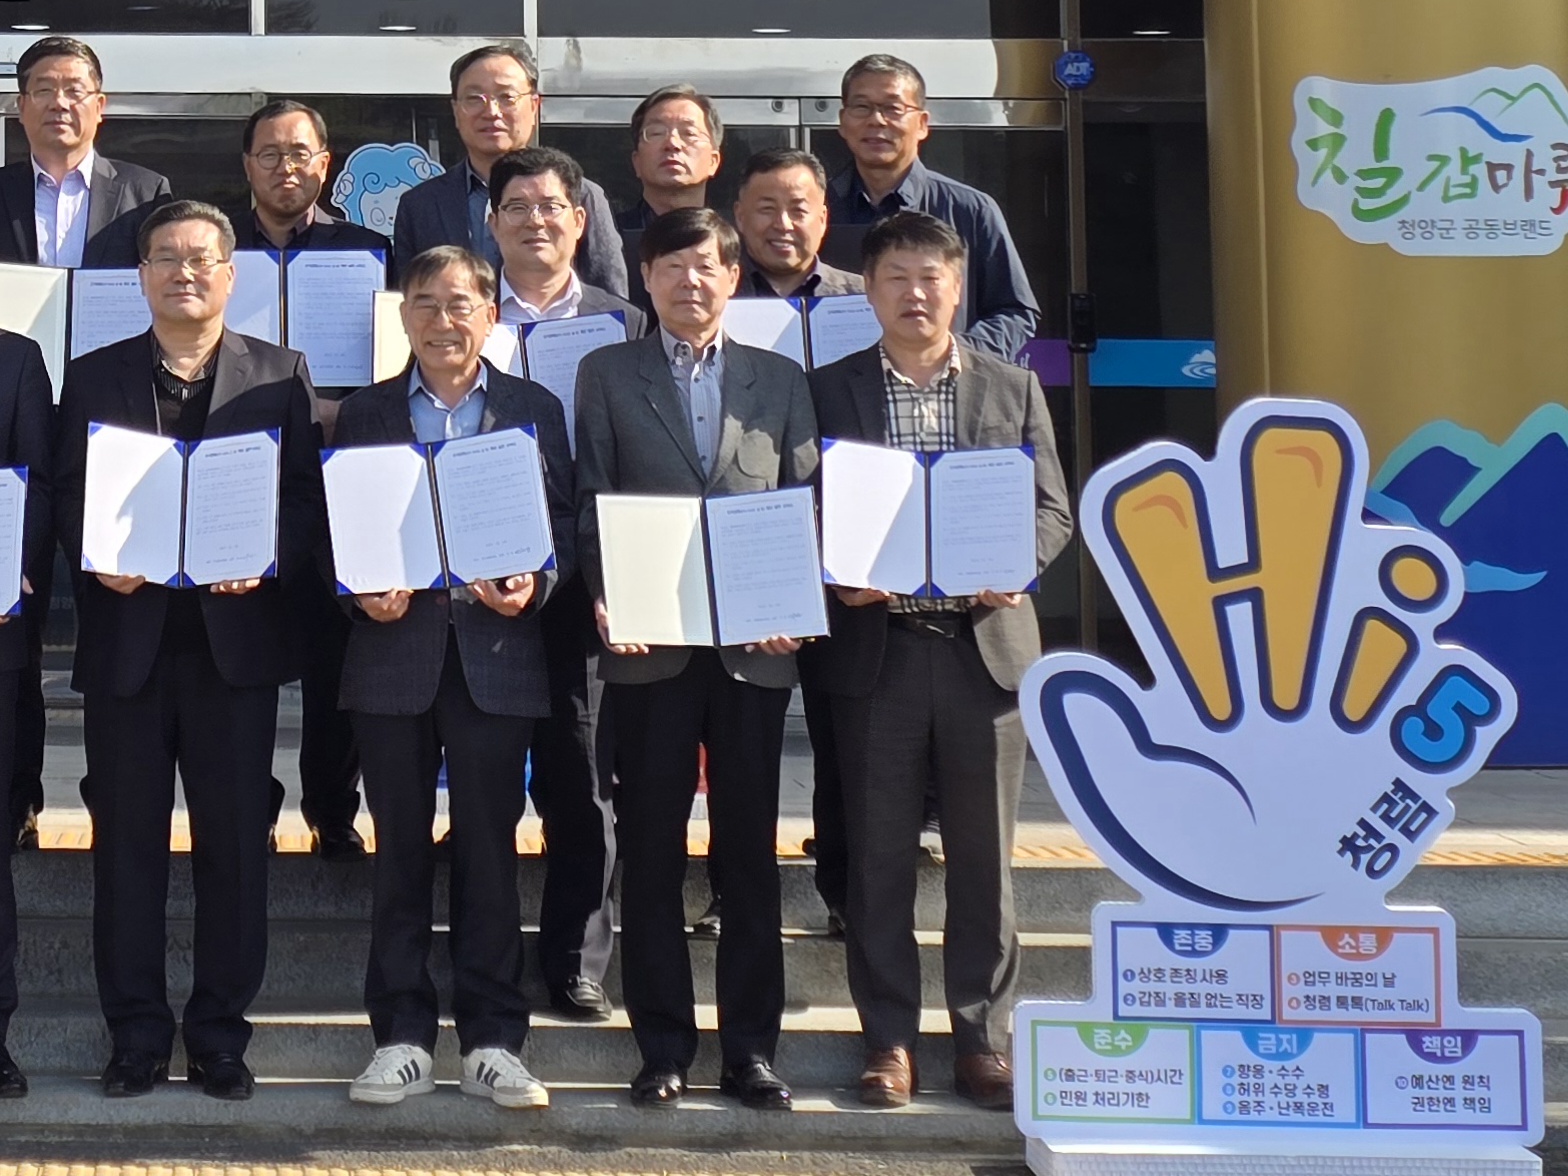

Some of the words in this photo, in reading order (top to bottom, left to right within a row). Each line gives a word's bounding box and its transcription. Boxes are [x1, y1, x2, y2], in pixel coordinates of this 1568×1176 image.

[1064, 62, 1090, 75] ADT
[1398, 219, 1457, 240] 청양군
[1462, 219, 1554, 240] 공동브랜드
[1336, 777, 1440, 880] 청렴
[1173, 929, 1213, 952] 존중
[1337, 933, 1377, 954] 소통
[1138, 967, 1167, 984] 상호
[1170, 968, 1198, 984] 존칭
[1200, 969, 1229, 985] 사용
[1303, 970, 1332, 987] 업무
[1335, 972, 1378, 988] 바꿈의
[1382, 973, 1397, 988] 날
[1205, 993, 1234, 1009] 없는
[1236, 993, 1265, 1010] 직장
[1303, 994, 1332, 1011] 청렴
[1094, 1029, 1133, 1050] 준수
[1258, 1033, 1298, 1054] 금지
[1421, 1035, 1462, 1057] 책임
[1238, 1082, 1265, 1097] 허위
[1269, 1083, 1298, 1098] 수당
[1302, 1084, 1330, 1099] 수령
[1411, 1074, 1456, 1091] 예산엔
[1461, 1074, 1491, 1091] 원칙
[1060, 1090, 1088, 1107] 민원
[1092, 1091, 1151, 1108] 처리기한
[1411, 1096, 1457, 1113] 권한엔
[1462, 1097, 1492, 1113] 책임
